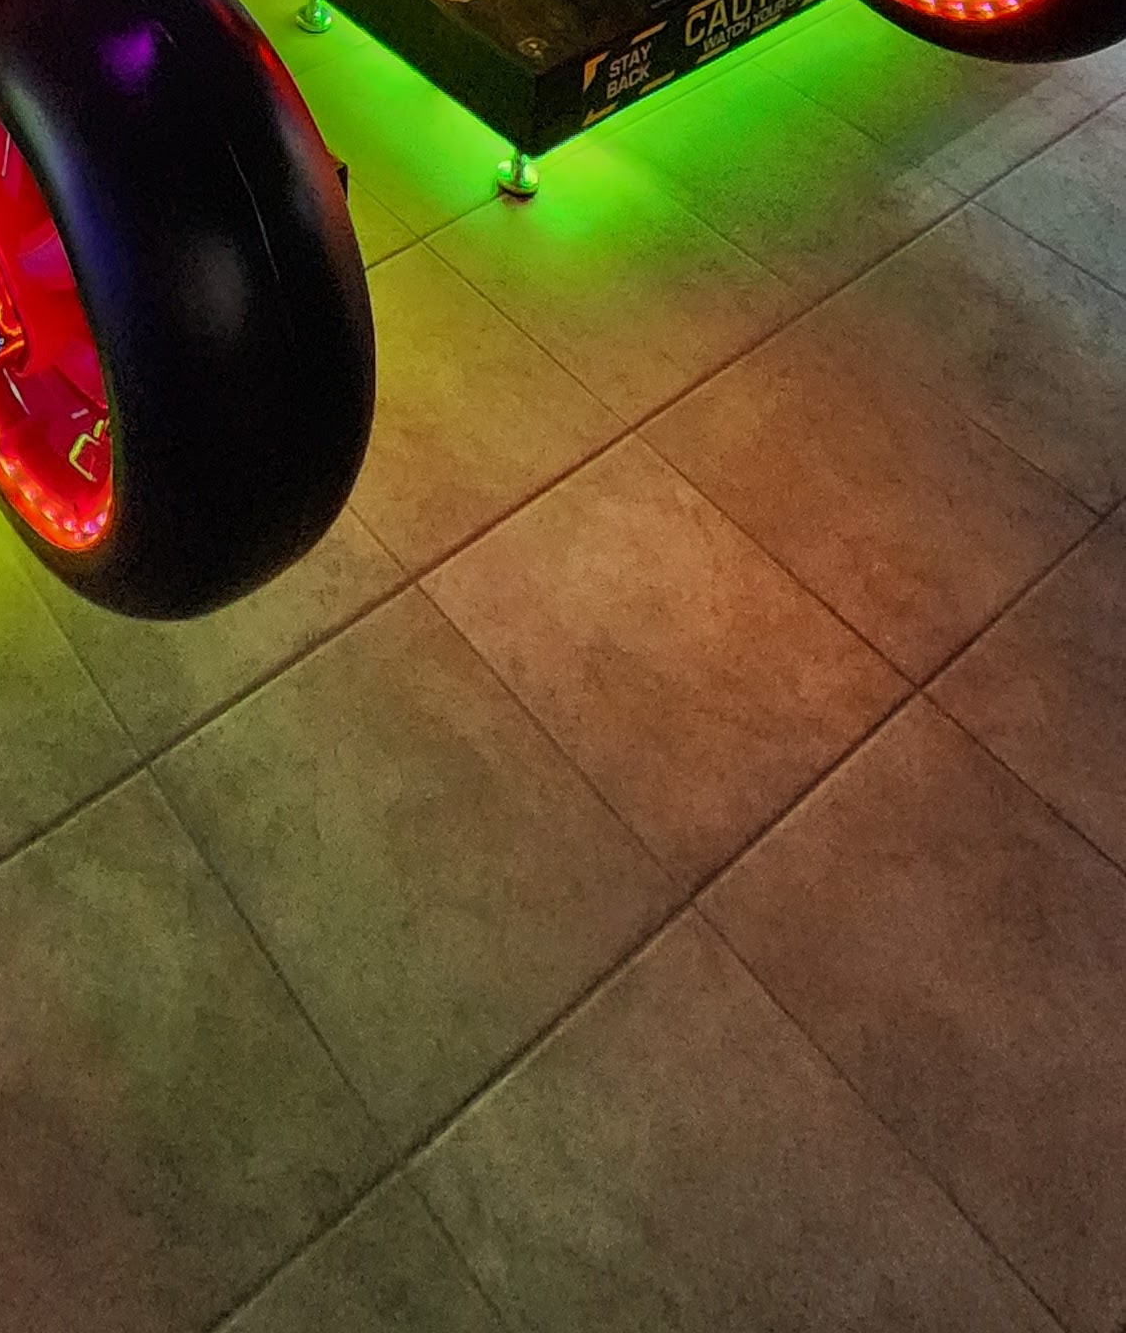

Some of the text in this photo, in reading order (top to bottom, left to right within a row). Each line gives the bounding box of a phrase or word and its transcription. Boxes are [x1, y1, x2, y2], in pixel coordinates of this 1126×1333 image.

[702, 16, 751, 52] WATCH
[608, 42, 652, 79] STAY
[606, 63, 651, 100] BACK
